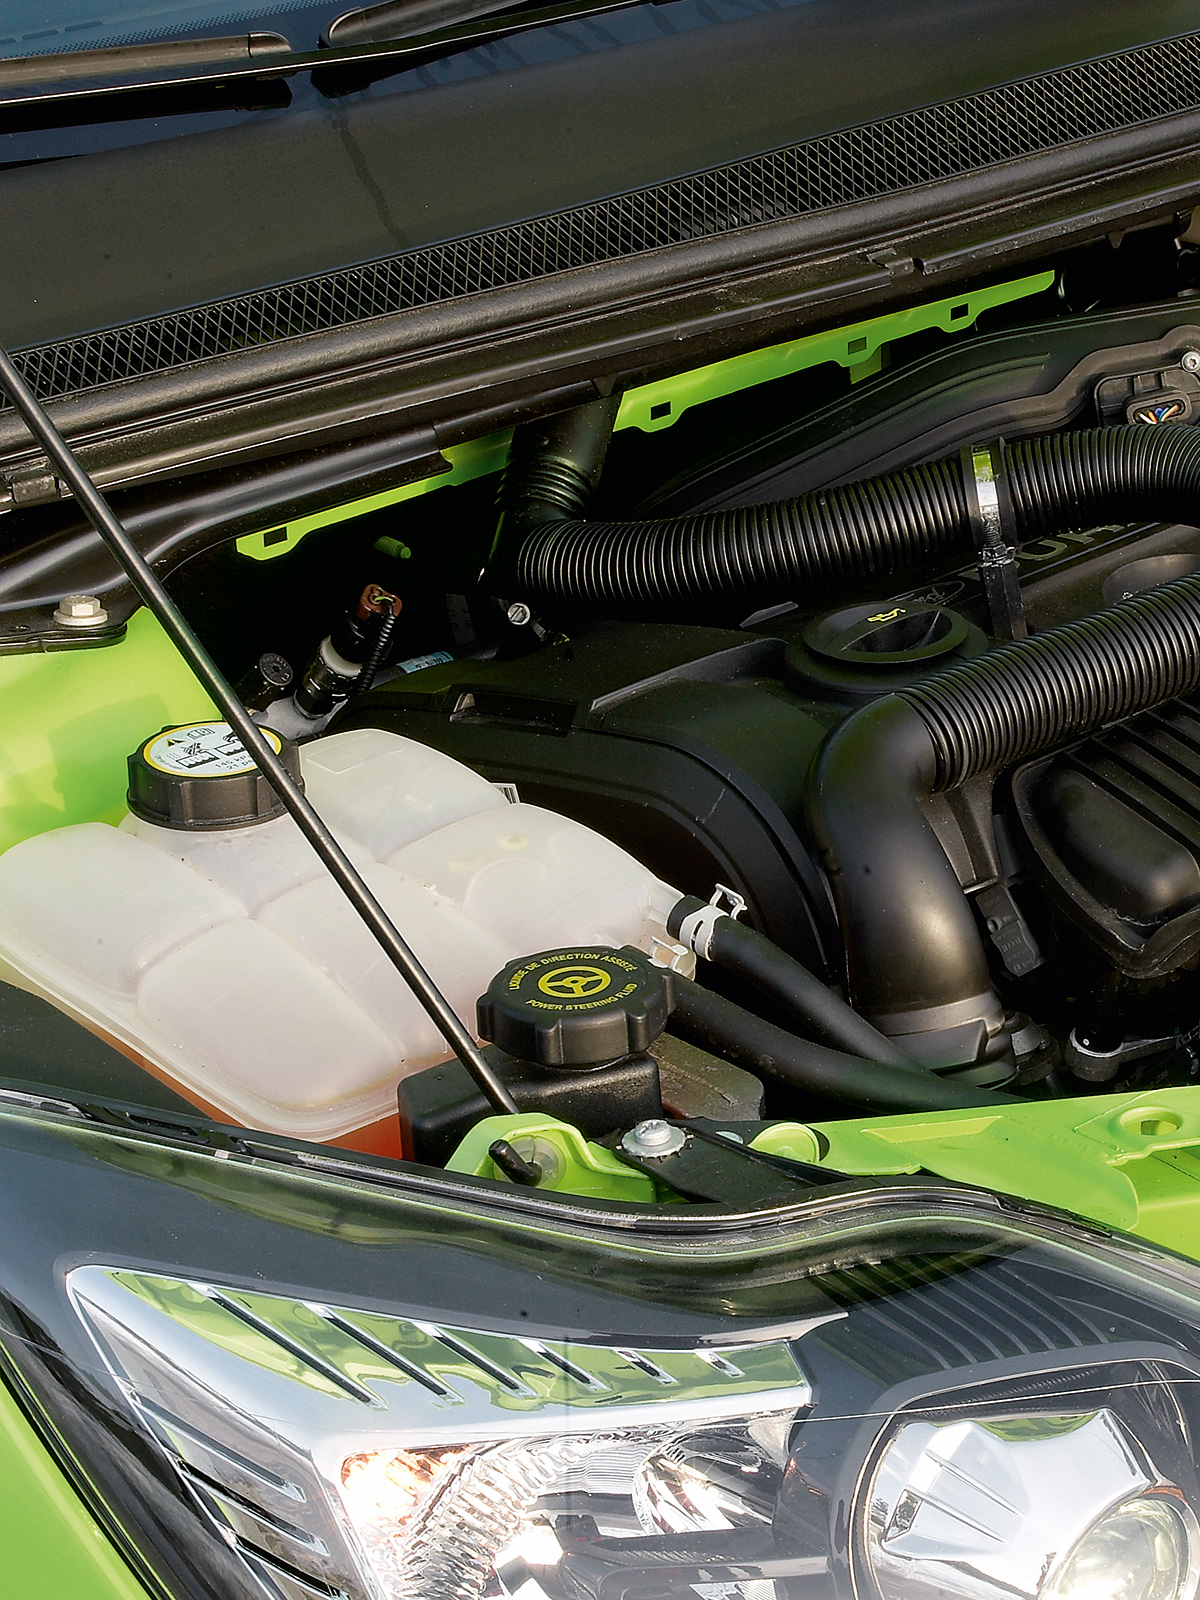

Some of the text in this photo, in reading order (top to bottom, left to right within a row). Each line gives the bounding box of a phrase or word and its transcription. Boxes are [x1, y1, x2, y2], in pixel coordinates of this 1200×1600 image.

[524, 961, 541, 971] DE
[540, 953, 600, 965] DIRECTION
[525, 983, 638, 1010] POWER STEERING FLUID
